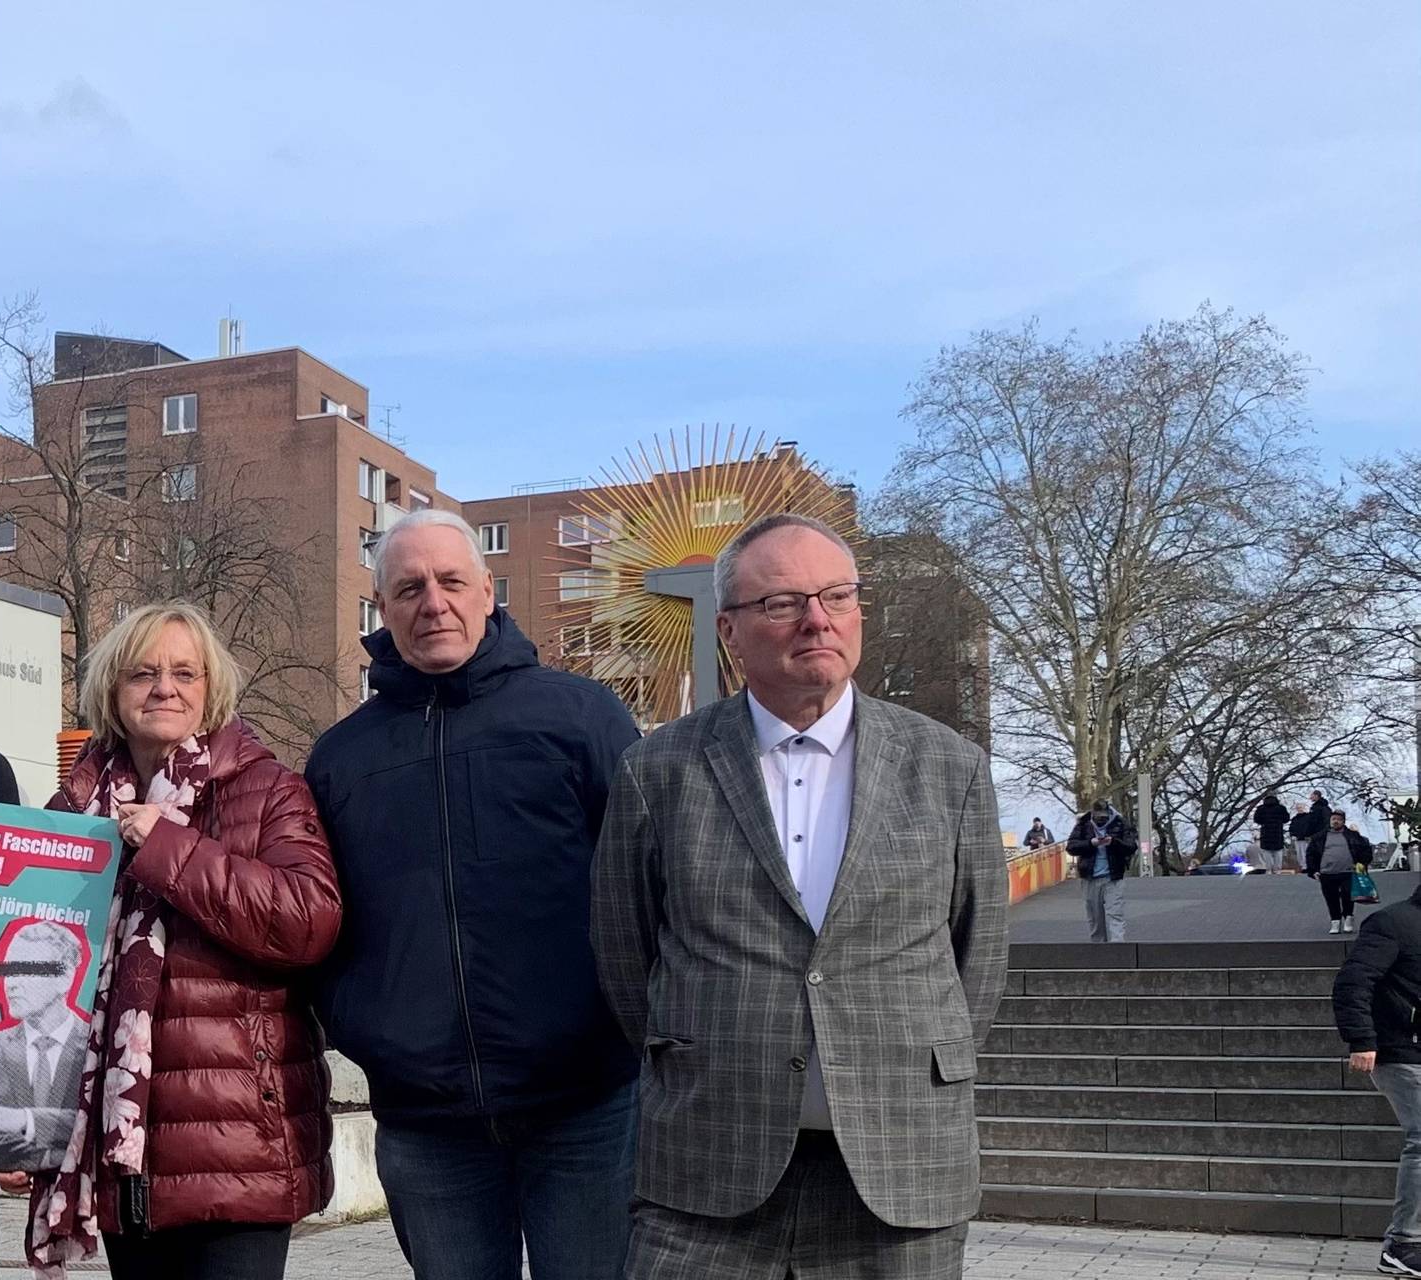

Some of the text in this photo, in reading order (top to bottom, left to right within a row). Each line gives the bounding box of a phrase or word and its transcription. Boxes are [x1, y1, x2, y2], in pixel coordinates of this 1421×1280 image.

[19, 662, 43, 686] Süd
[2, 832, 95, 863] Faschisten
[33, 901, 92, 927] Höcke!
